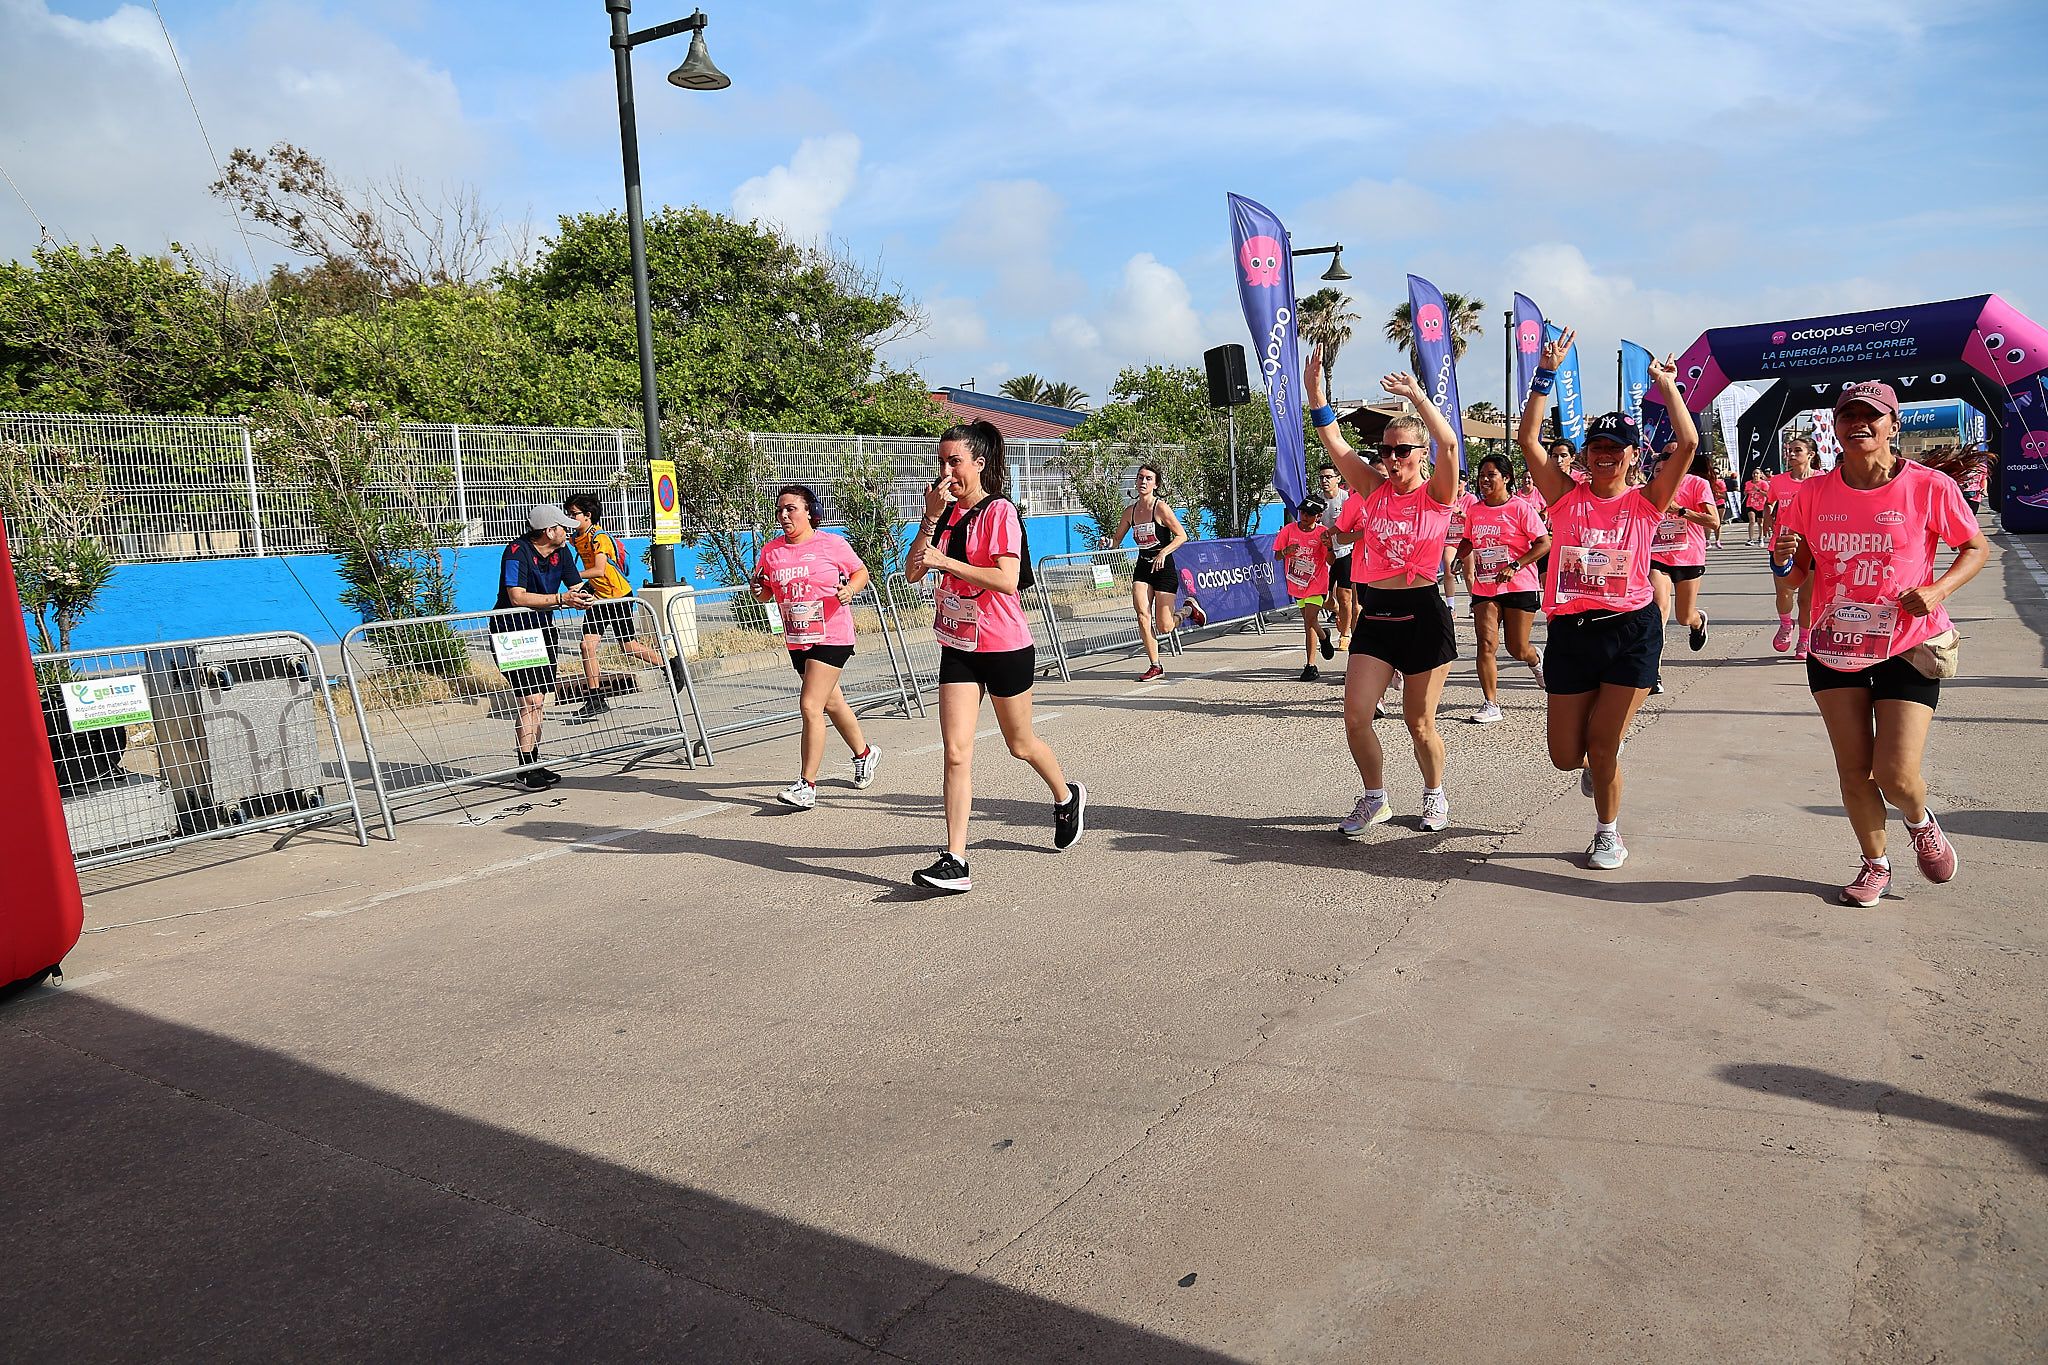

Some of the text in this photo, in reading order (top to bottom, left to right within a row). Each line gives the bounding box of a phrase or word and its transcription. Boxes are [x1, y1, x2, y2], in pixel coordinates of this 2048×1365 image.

[1791, 318, 1911, 341] octopus energy
[1762, 337, 1915, 360] LA ENERGÍA PARA CORRER
[1761, 347, 1918, 370] A LA VELOCIDAD DE LA LUZ
[1811, 373, 1947, 394] VOVO
[2006, 463, 2039, 472] octopus
[1818, 513, 1848, 522] OYSHO
[1820, 532, 1894, 553] CARRERA
[1482, 562, 1497, 570] 016
[1197, 561, 1275, 591] octopus energy
[1581, 574, 1606, 586] 016
[942, 616, 959, 630] 016
[1832, 631, 1864, 645] 016
[93, 684, 137, 700] geiser
